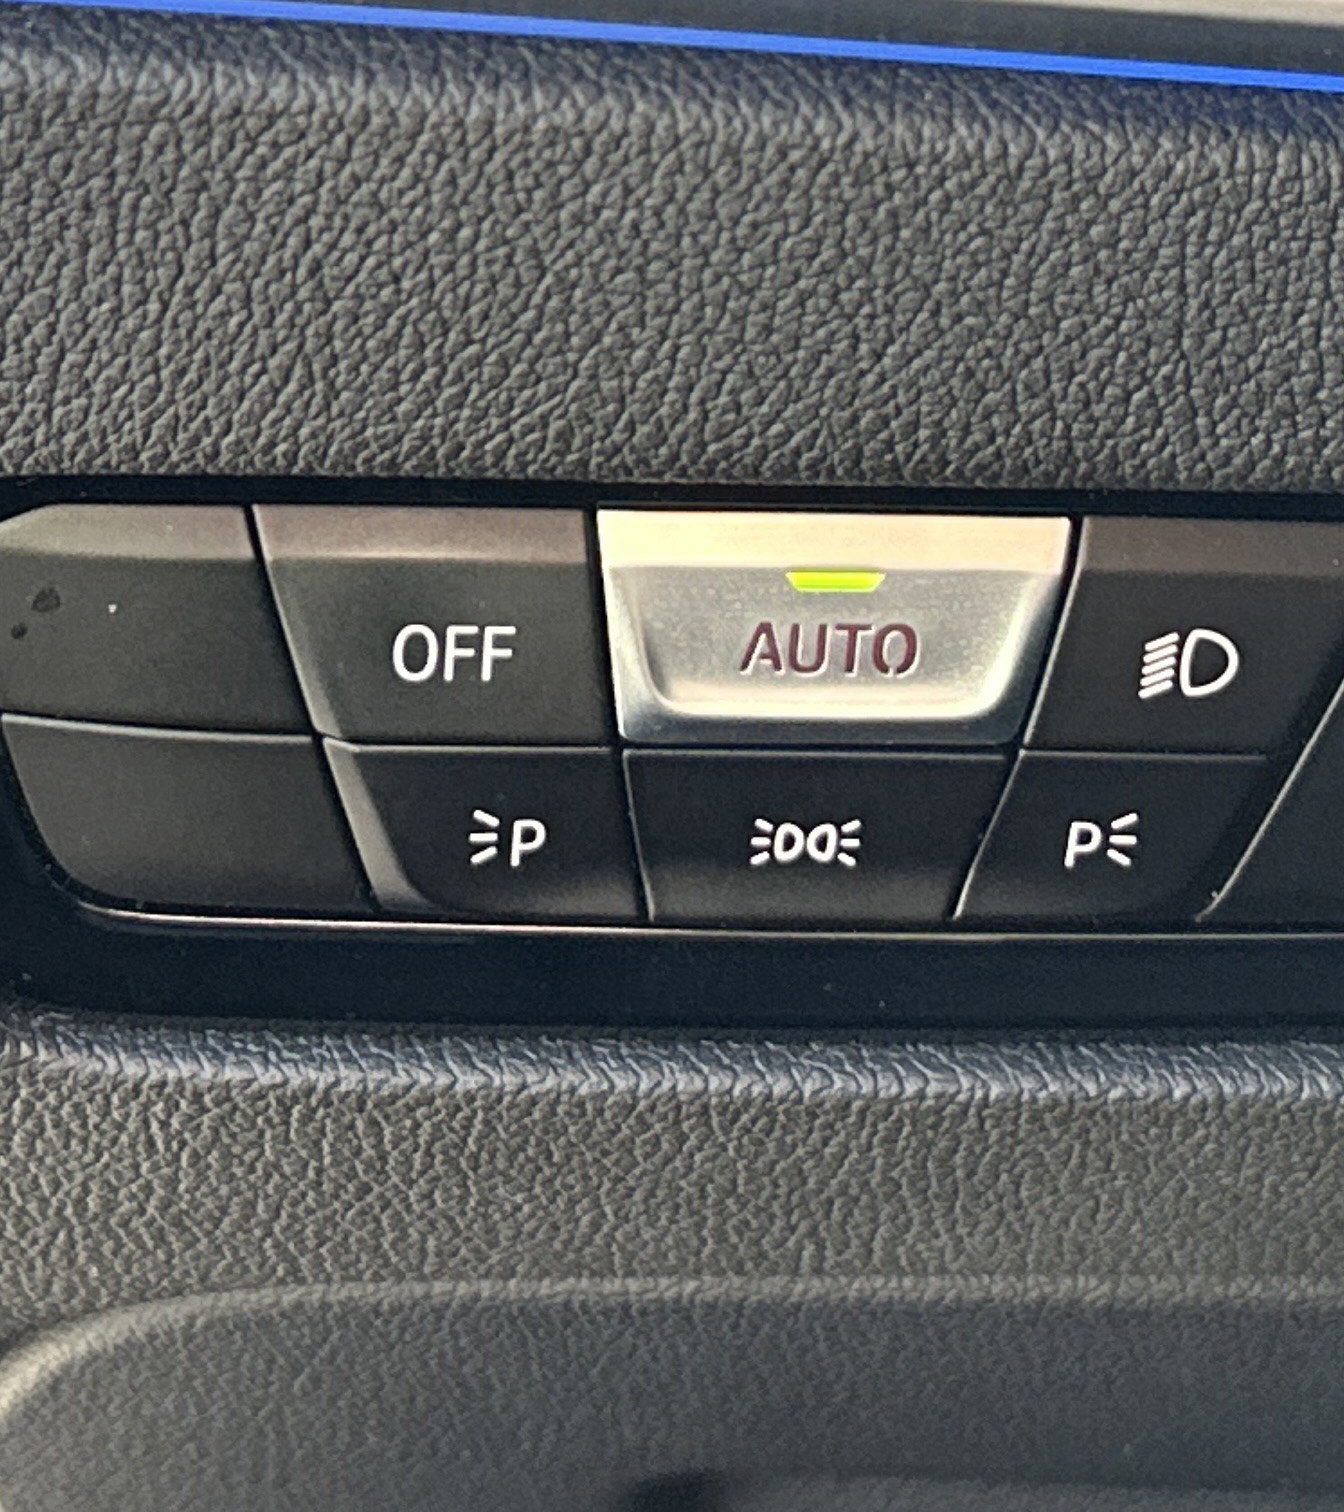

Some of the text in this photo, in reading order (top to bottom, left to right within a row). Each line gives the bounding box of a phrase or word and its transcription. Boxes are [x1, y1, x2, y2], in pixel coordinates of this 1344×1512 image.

[392, 625, 516, 682] OFF
[739, 622, 919, 676] AUTO
[510, 819, 546, 867] P
[1064, 820, 1102, 867] P
